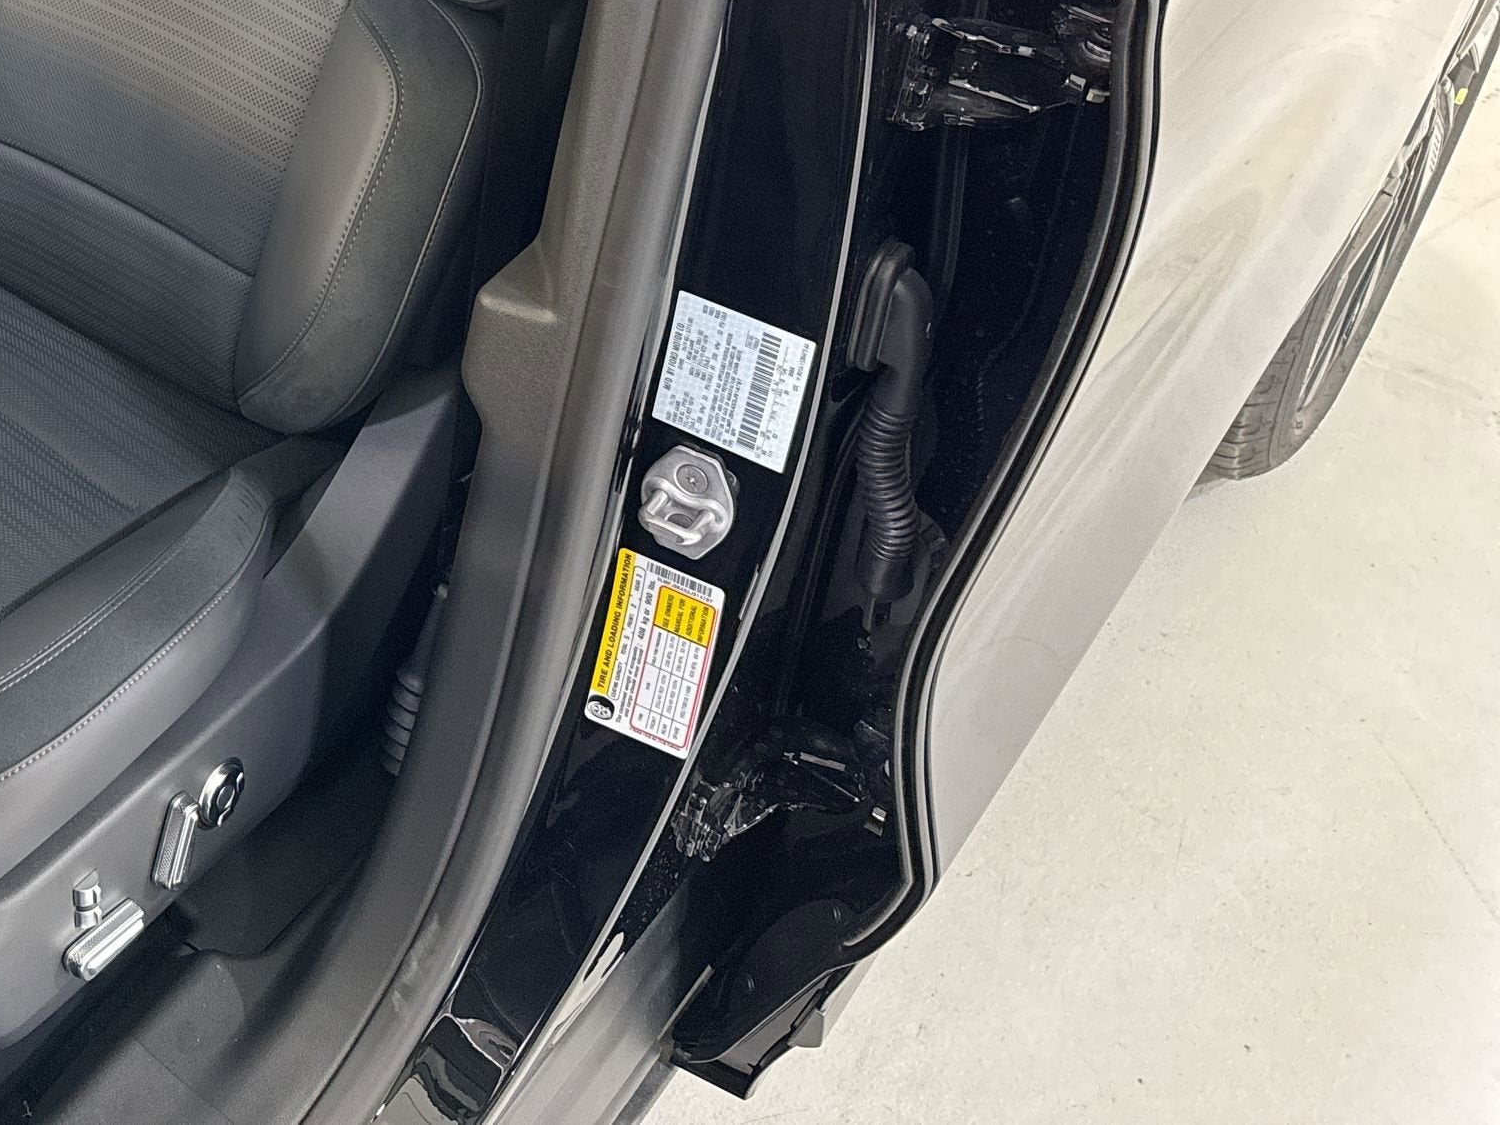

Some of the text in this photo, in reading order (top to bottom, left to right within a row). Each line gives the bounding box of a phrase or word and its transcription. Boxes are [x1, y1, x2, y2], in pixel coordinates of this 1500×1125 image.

[673, 331, 682, 351] MOTOR
[668, 351, 678, 367] FORD
[666, 366, 675, 376] BY
[645, 592, 653, 605] 900
[644, 608, 650, 616] or
[597, 554, 631, 688] TIRE AND LOADING INFORMATION
[641, 616, 650, 625] kg
[662, 617, 670, 628] SEE
[674, 611, 683, 633] MANUAL
[686, 606, 697, 636] ADDITIONAL
[697, 607, 709, 642] INFORMATION
[638, 627, 646, 640] 408
